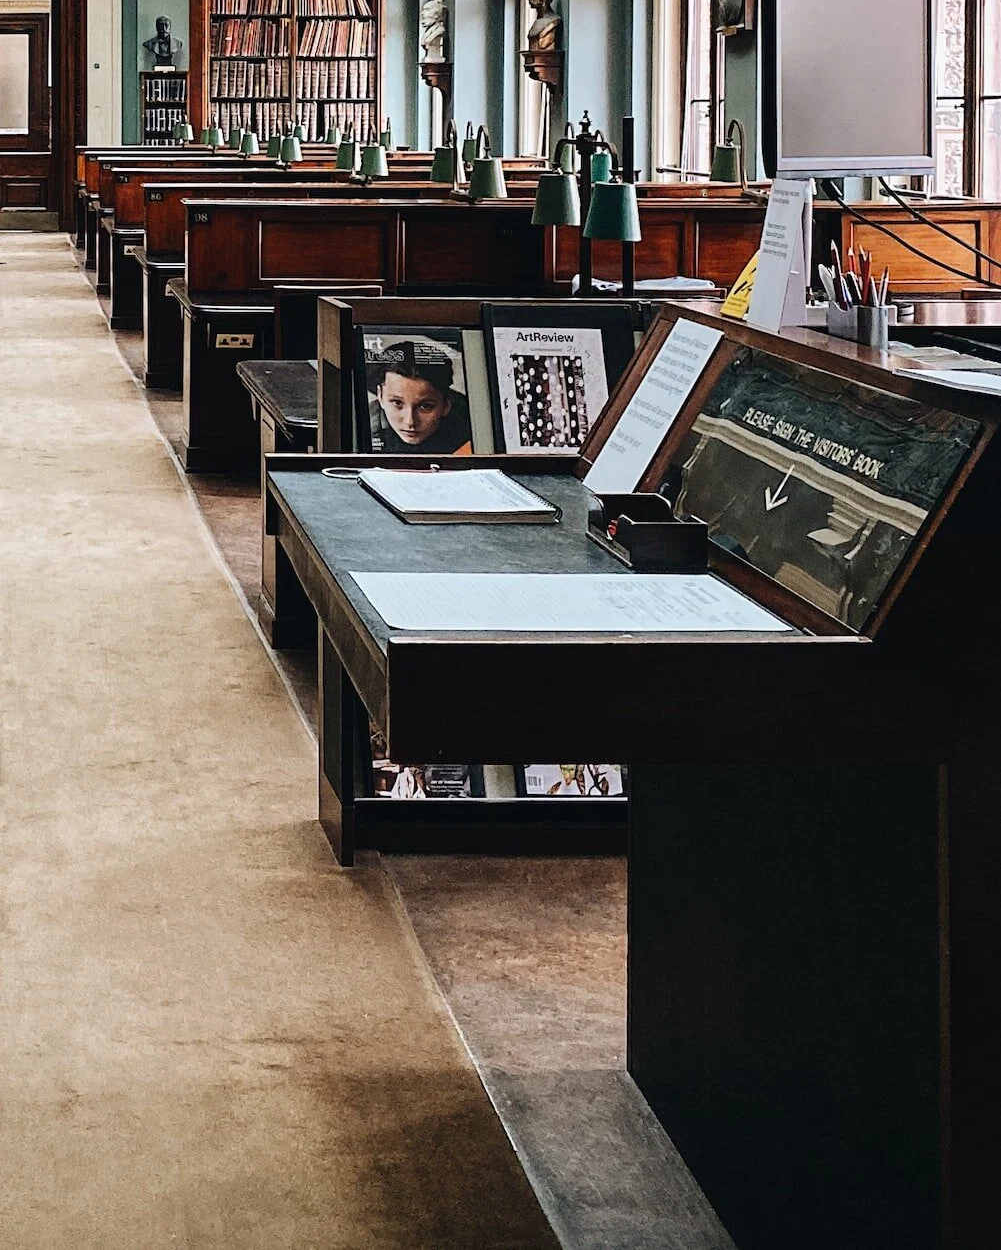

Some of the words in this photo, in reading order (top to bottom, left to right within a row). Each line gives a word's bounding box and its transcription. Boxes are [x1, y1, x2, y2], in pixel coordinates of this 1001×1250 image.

[194, 213, 208, 222] 98
[516, 332, 575, 342] ArtReview
[742, 407, 775, 431] PLEASE
[772, 419, 797, 441] SIGN
[793, 427, 815, 449] THE
[812, 436, 859, 467] VISITORS'
[852, 453, 885, 480] BOOK
